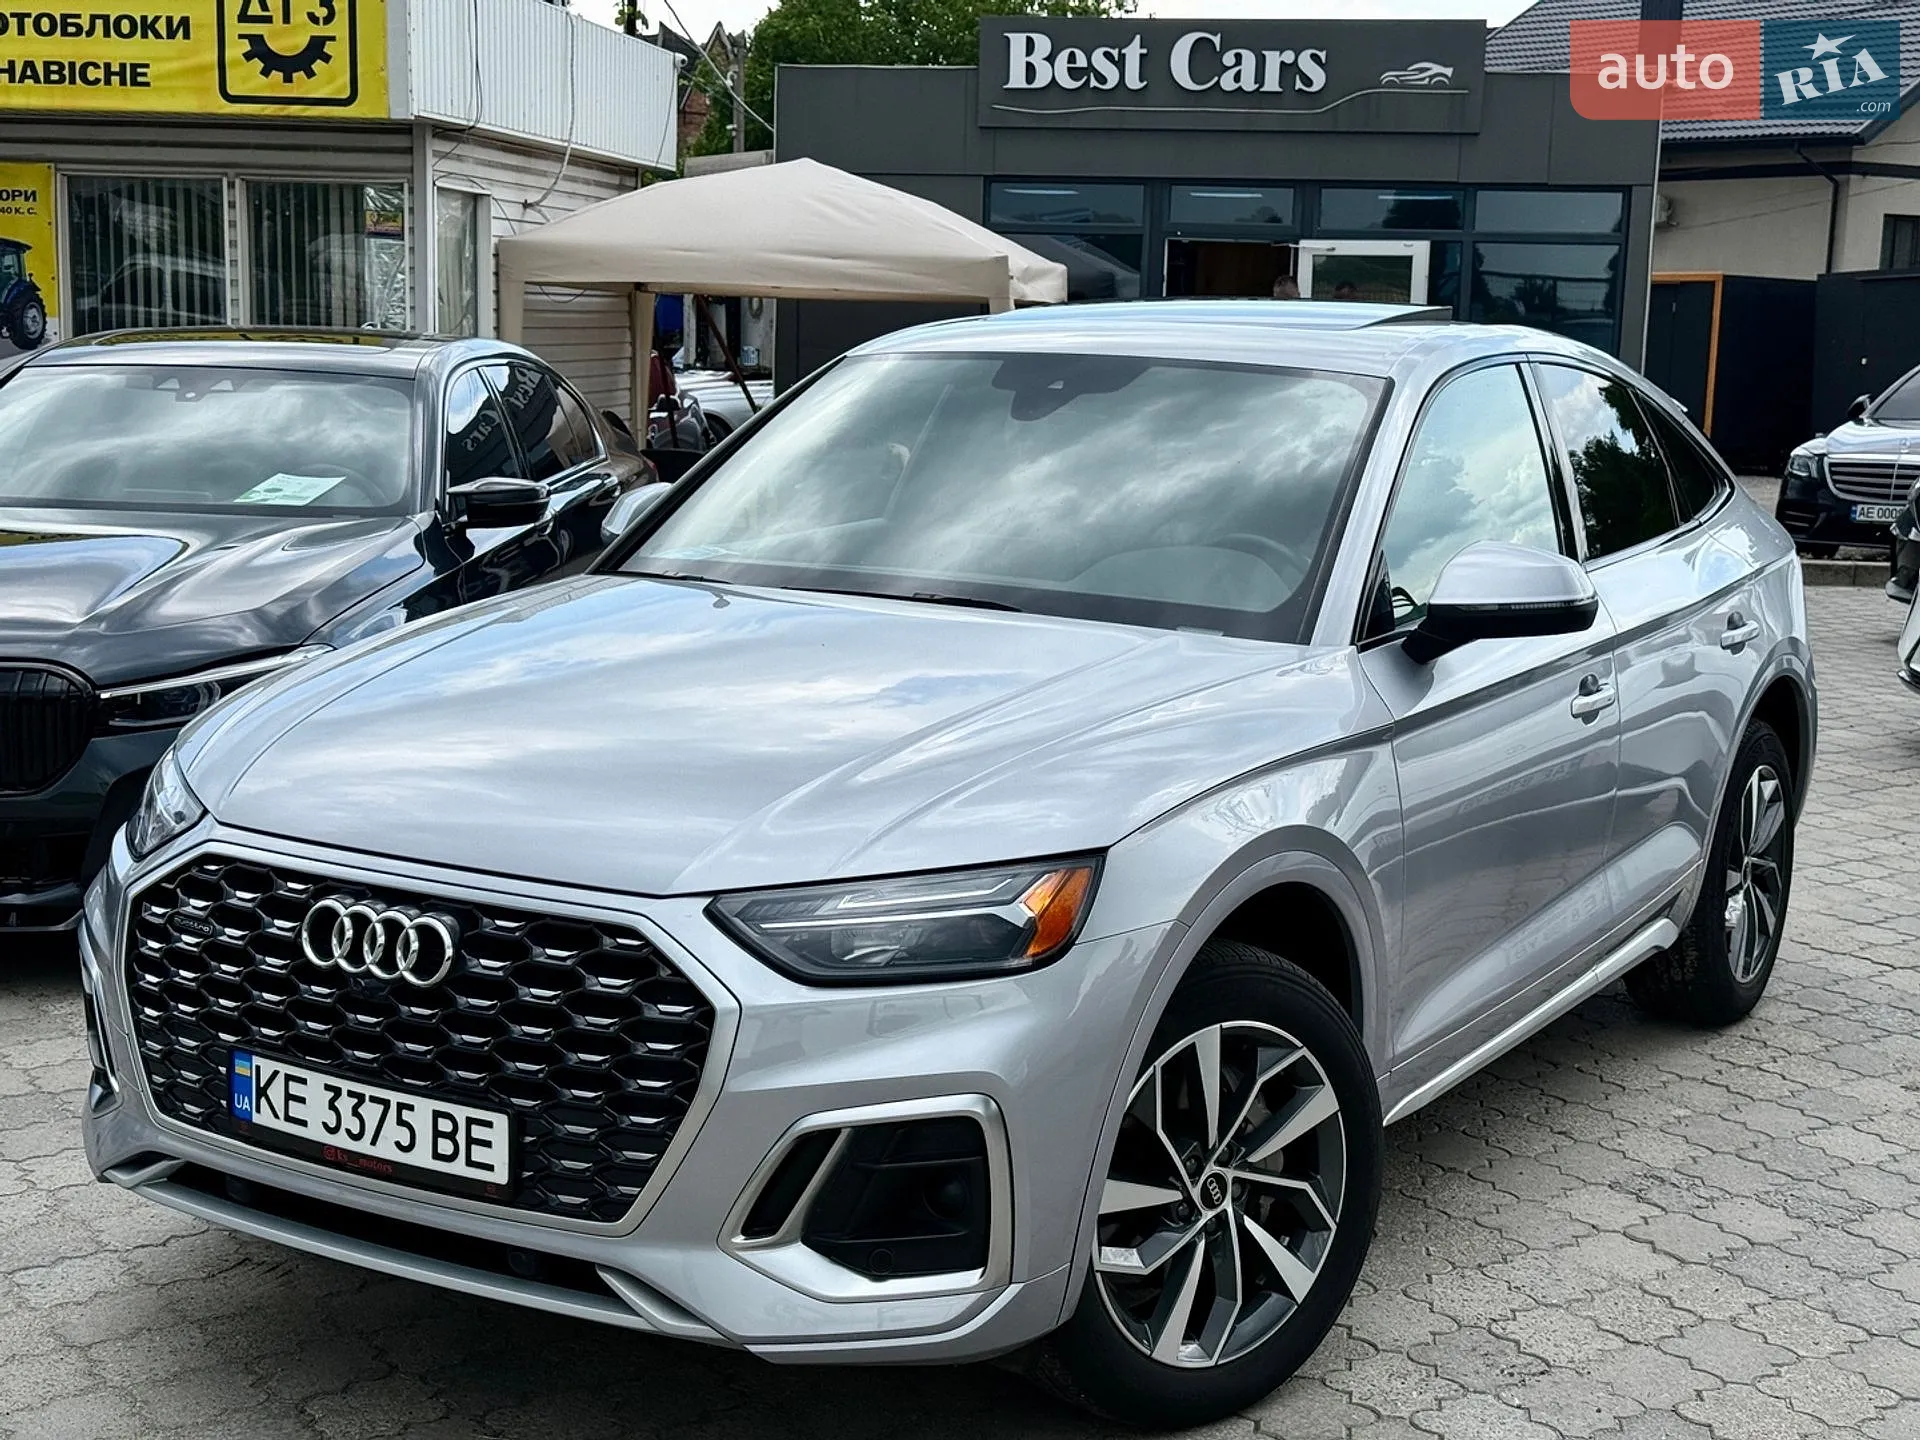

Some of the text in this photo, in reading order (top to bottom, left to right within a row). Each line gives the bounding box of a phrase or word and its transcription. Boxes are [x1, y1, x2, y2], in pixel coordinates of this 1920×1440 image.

[1003, 31, 1328, 92] Best Cars
[1858, 506, 1875, 518] AE
[234, 1093, 251, 1112] UA
[255, 1064, 495, 1172] KE 3375 BE
